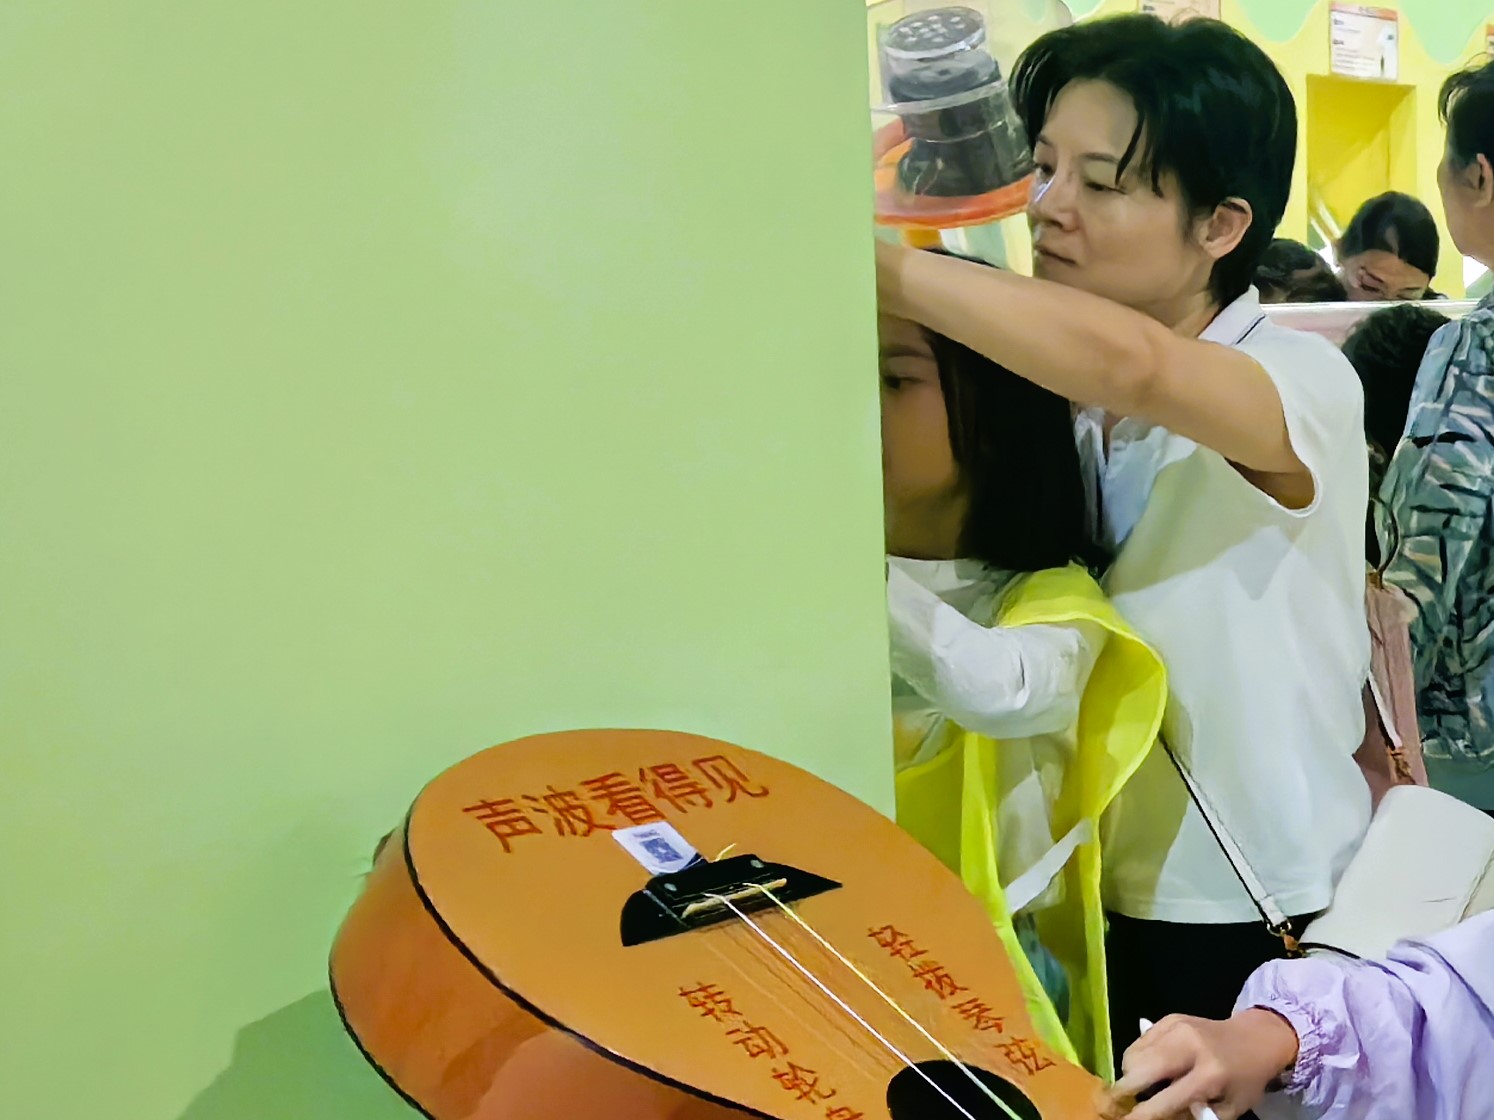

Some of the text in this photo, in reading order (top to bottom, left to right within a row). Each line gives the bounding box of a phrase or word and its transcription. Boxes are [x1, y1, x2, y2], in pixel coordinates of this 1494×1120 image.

[462, 755, 769, 853] 声波看得见
